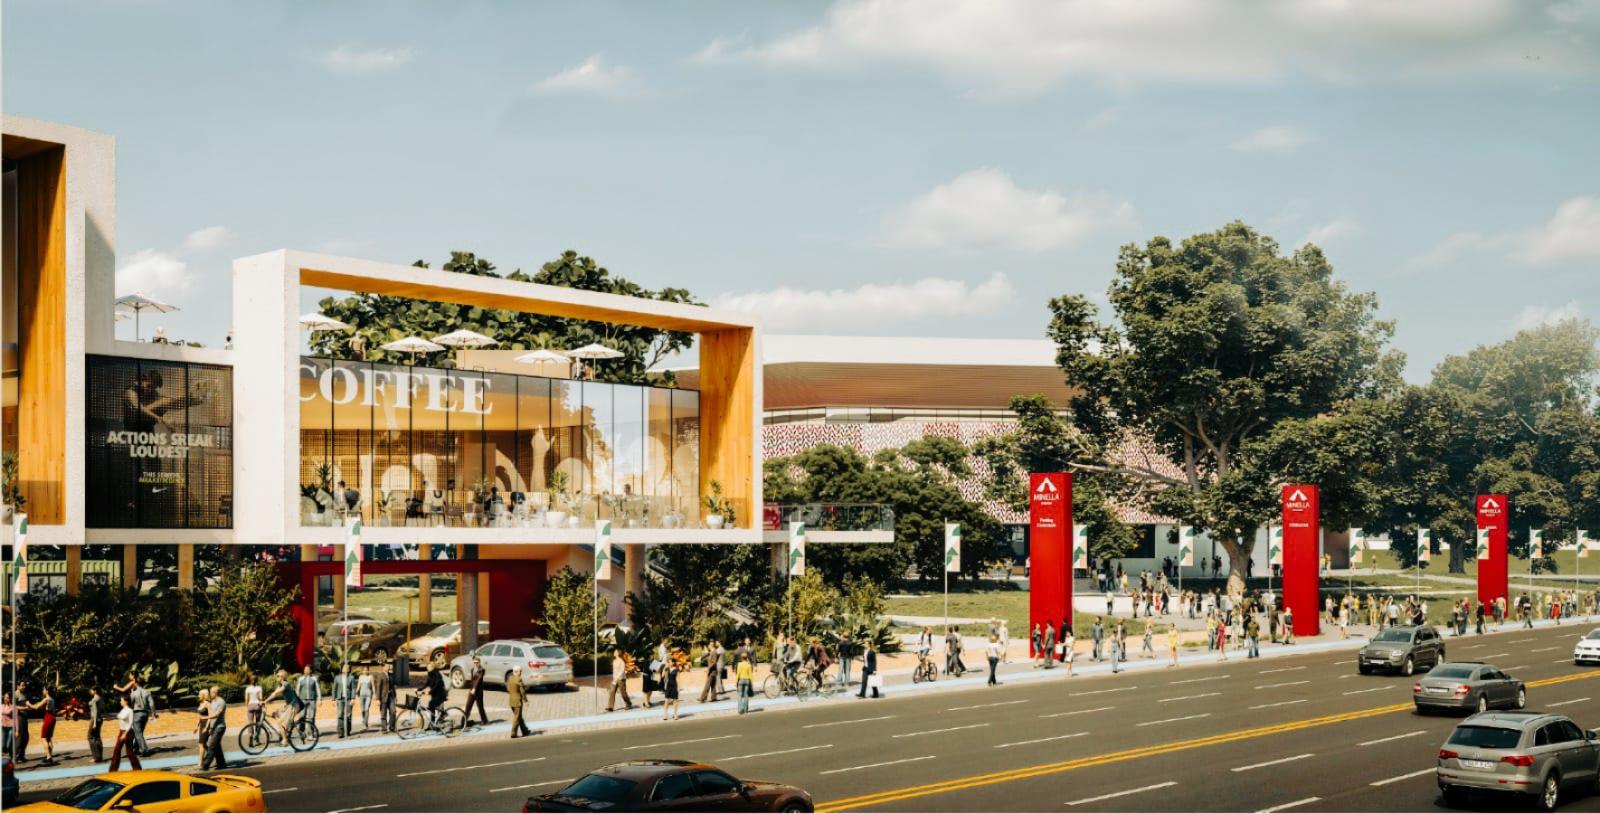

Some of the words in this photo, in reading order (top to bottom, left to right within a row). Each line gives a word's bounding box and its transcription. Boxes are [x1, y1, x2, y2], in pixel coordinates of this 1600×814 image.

[299, 363, 493, 415] COFFEE
[107, 431, 167, 446] ACTIONS
[130, 445, 189, 458] LOUDEST
